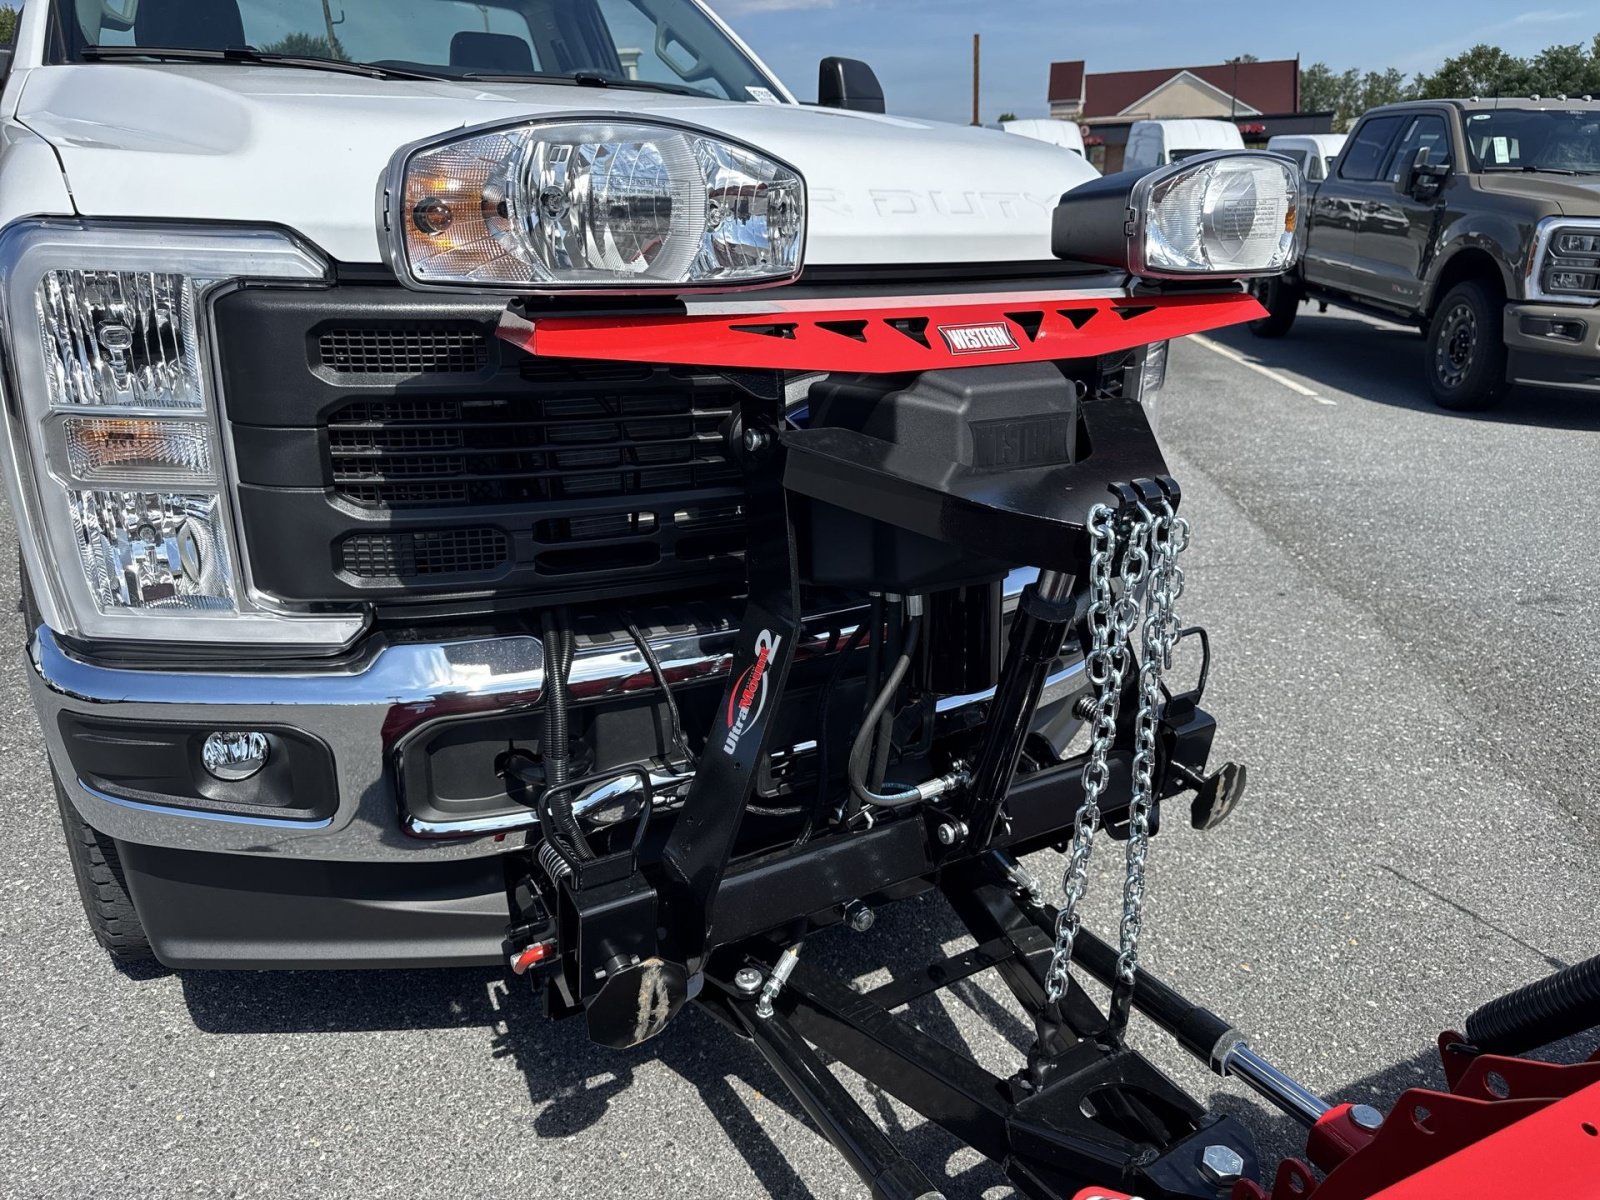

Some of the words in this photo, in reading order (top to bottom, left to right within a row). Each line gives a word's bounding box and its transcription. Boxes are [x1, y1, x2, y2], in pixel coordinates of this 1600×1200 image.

[867, 188, 1061, 218] DUTY
[946, 326, 1011, 350] WESTERN
[974, 420, 1066, 468] WESTERN
[723, 647, 770, 755] UltraMount
